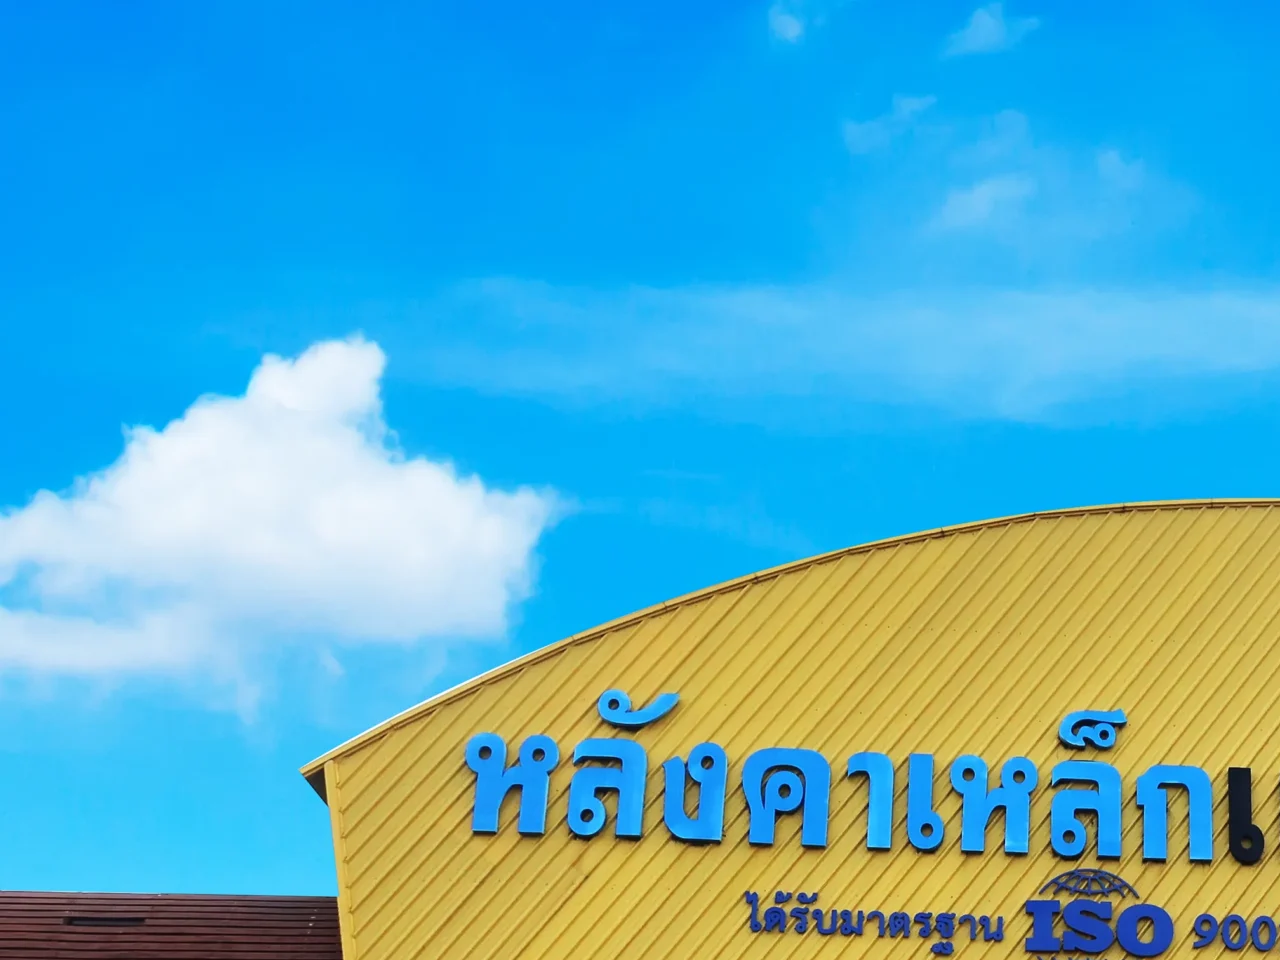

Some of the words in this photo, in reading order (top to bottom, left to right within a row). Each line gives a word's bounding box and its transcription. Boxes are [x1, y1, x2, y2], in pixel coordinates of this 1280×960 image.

[745, 891, 1004, 955] ได้รับมาตรฐาน
[1025, 899, 1174, 958] ISO
